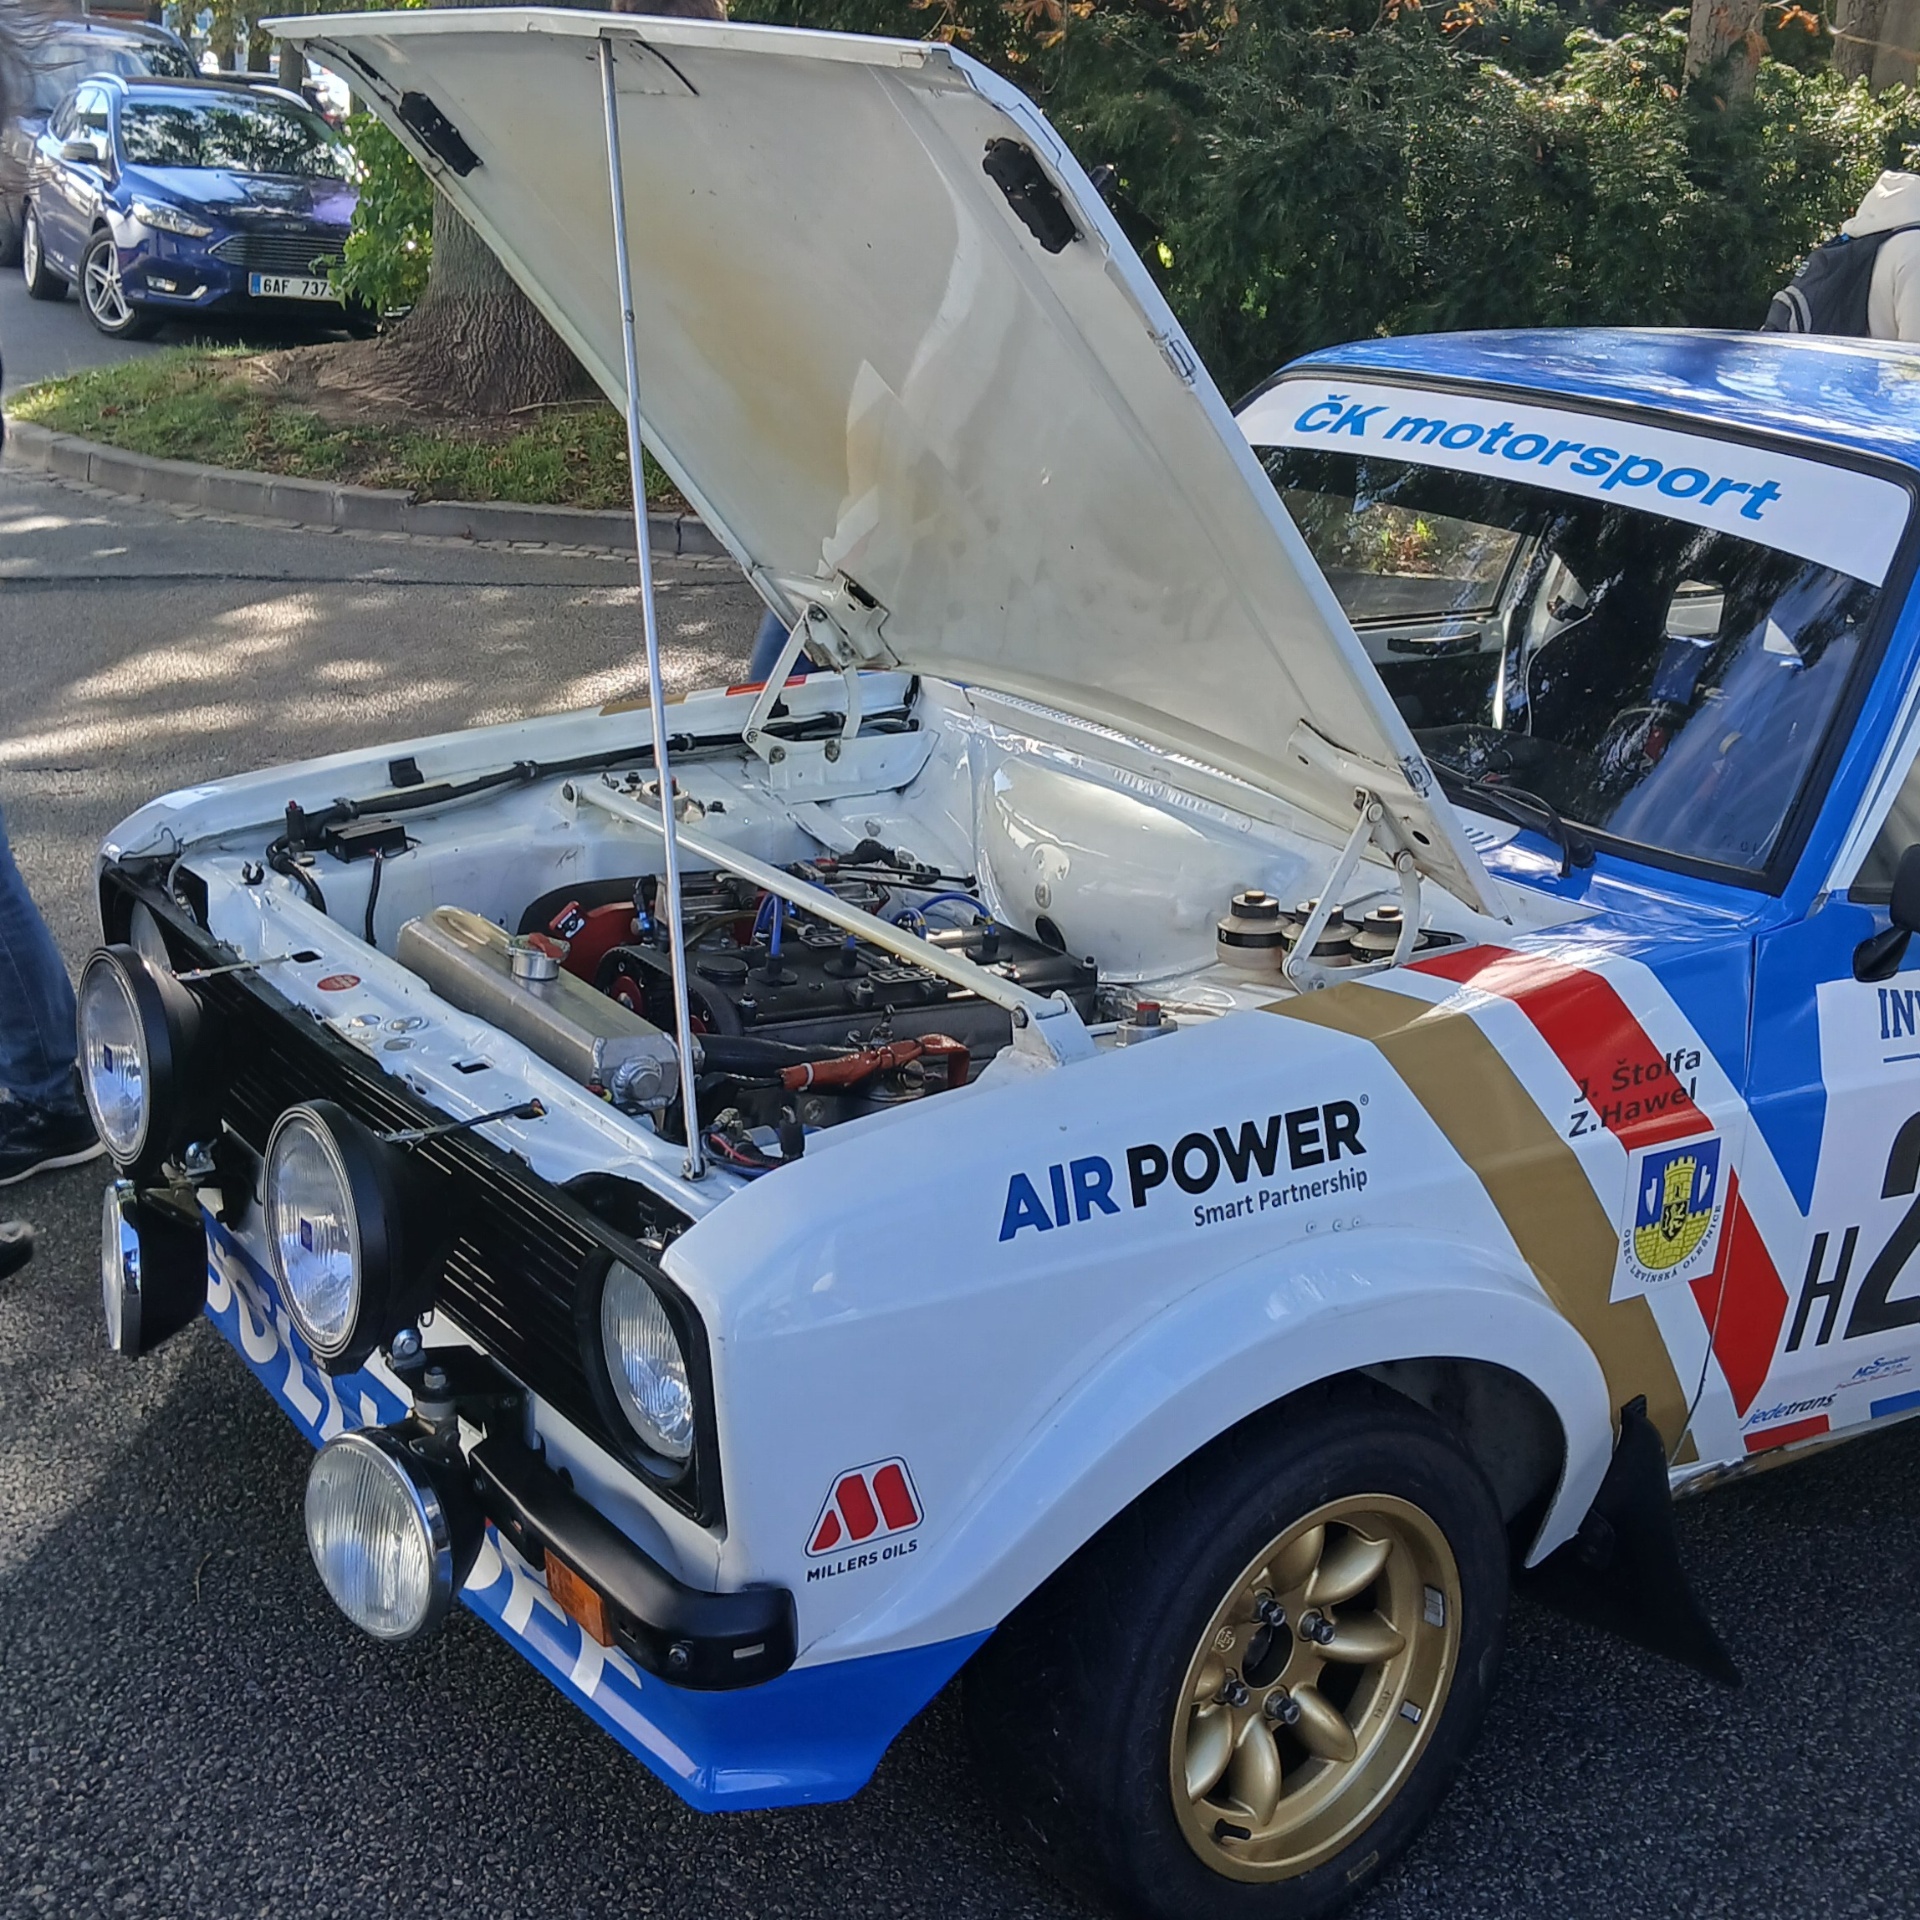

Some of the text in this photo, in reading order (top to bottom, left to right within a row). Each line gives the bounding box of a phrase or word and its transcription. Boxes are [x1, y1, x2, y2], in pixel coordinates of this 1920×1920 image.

[263, 278, 334, 297] 6AF 737
[1293, 393, 1783, 521] ČK motorsport
[1573, 1047, 1701, 1104] J. Štolfa
[1193, 1166, 1368, 1228] Smart Partnership
[1623, 1204, 1722, 1283] OBEC LEVÍNSKÁ OLEŠNICE
[1739, 1392, 1838, 1431] jedetrans
[806, 1539, 918, 1583] MILLERS OILS
